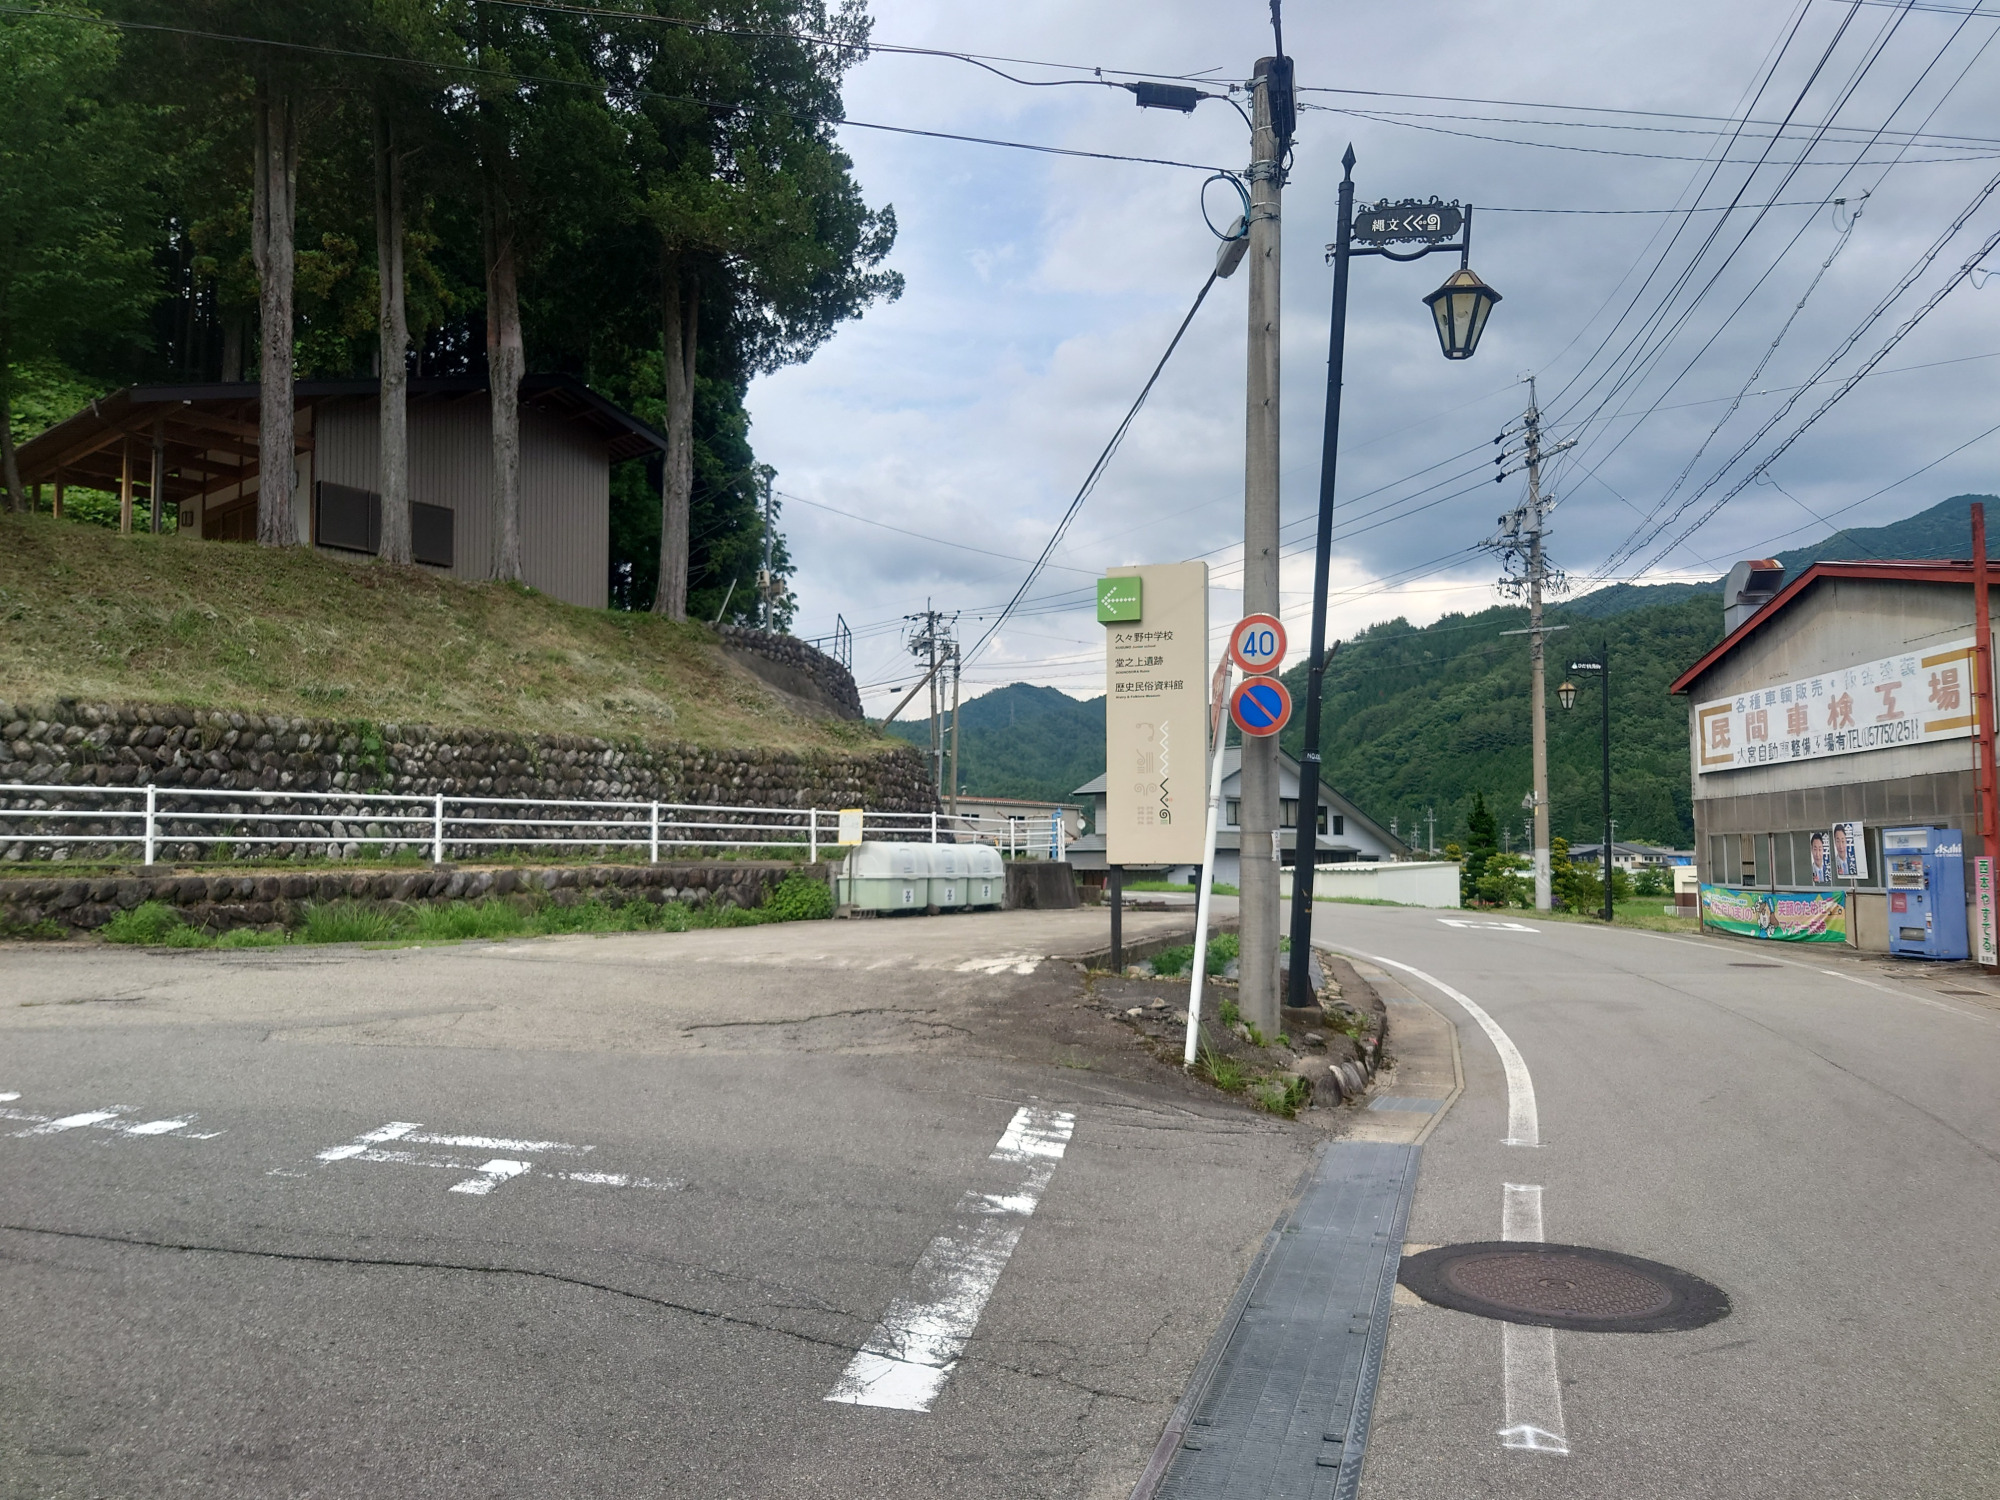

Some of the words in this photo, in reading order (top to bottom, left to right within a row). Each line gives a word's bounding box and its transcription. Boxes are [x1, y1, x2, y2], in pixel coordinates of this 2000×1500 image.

[1115, 630, 1174, 643] 久々野中学校
[1243, 631, 1275, 657] 40
[1115, 656, 1164, 668] 堂之上遺跡
[1115, 680, 1184, 692] 歴史民俗資料館
[1711, 667, 1961, 750] 民間車検工場
[1934, 843, 1962, 854] Asahi
[1778, 900, 1828, 917] 笑顔のために
